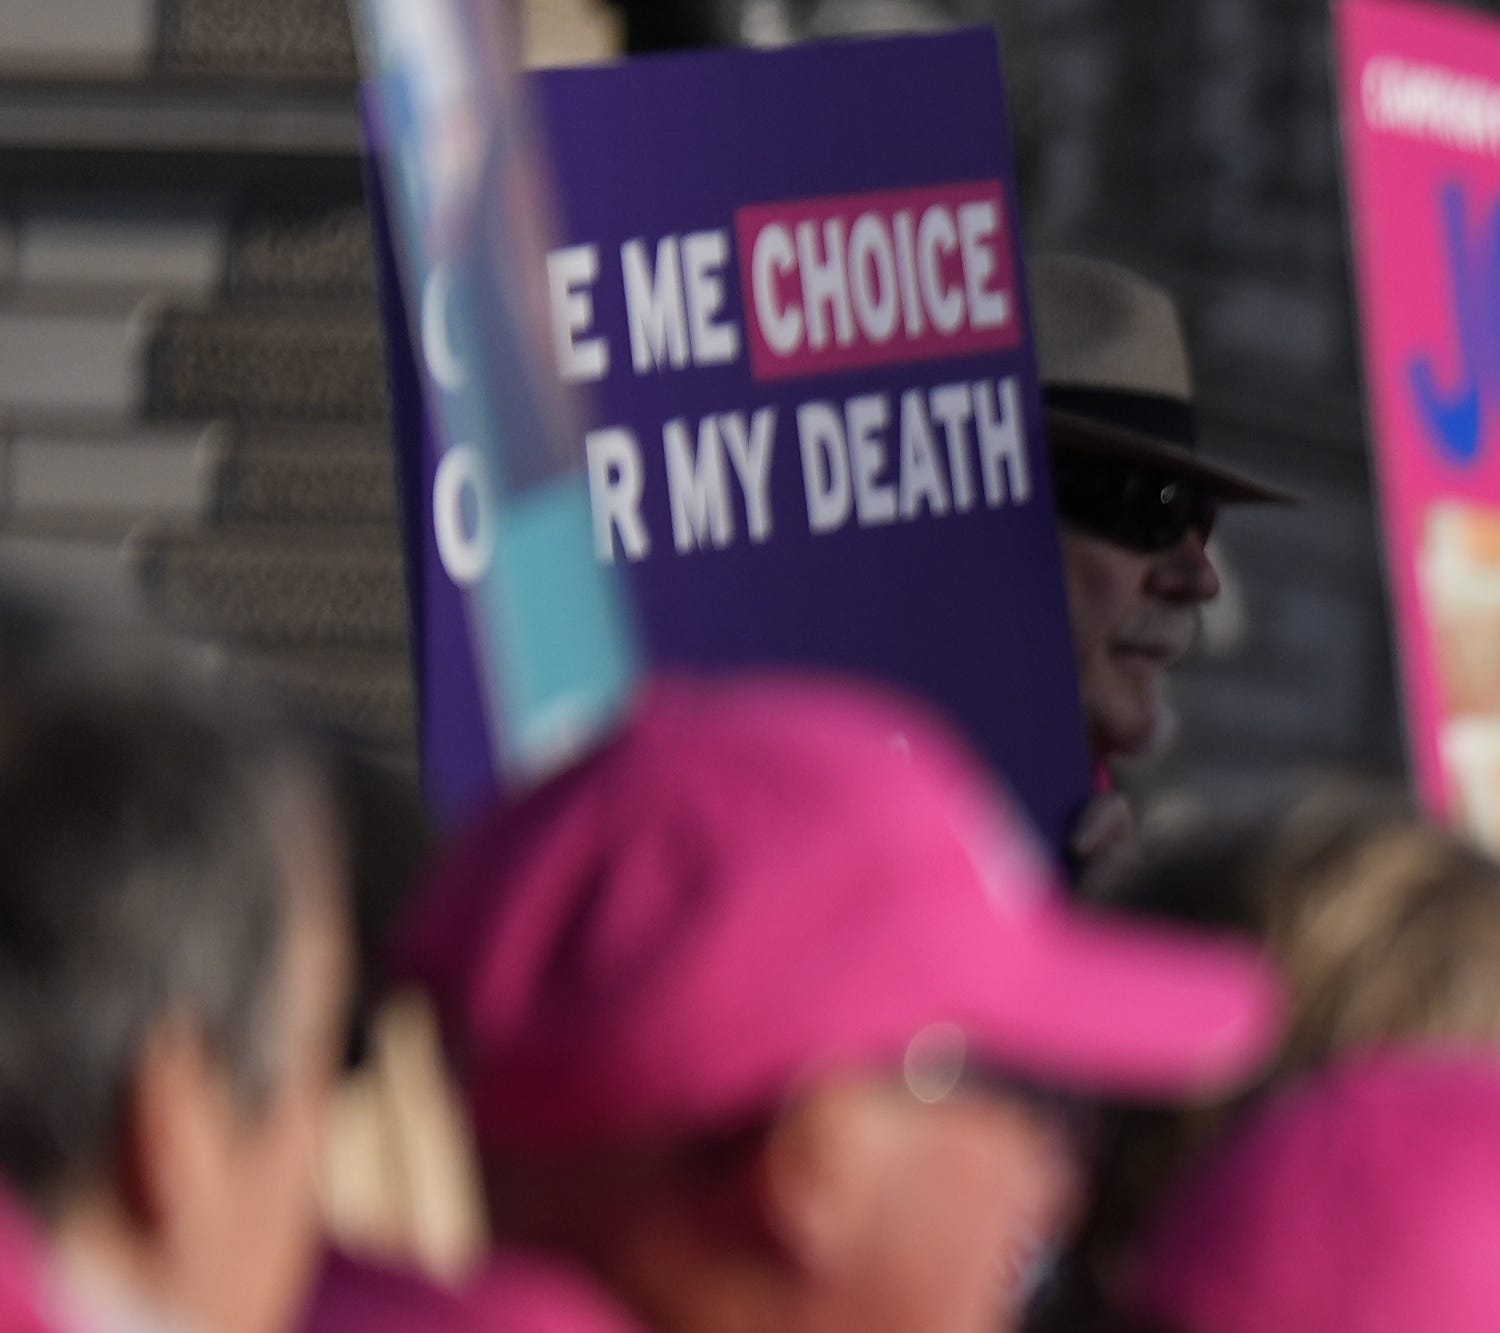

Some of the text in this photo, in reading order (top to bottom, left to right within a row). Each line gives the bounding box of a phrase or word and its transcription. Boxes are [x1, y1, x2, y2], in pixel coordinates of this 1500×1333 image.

[621, 231, 739, 374] ME
[750, 199, 1009, 358] CHOICE
[432, 377, 1031, 586] OR MY DEATH
